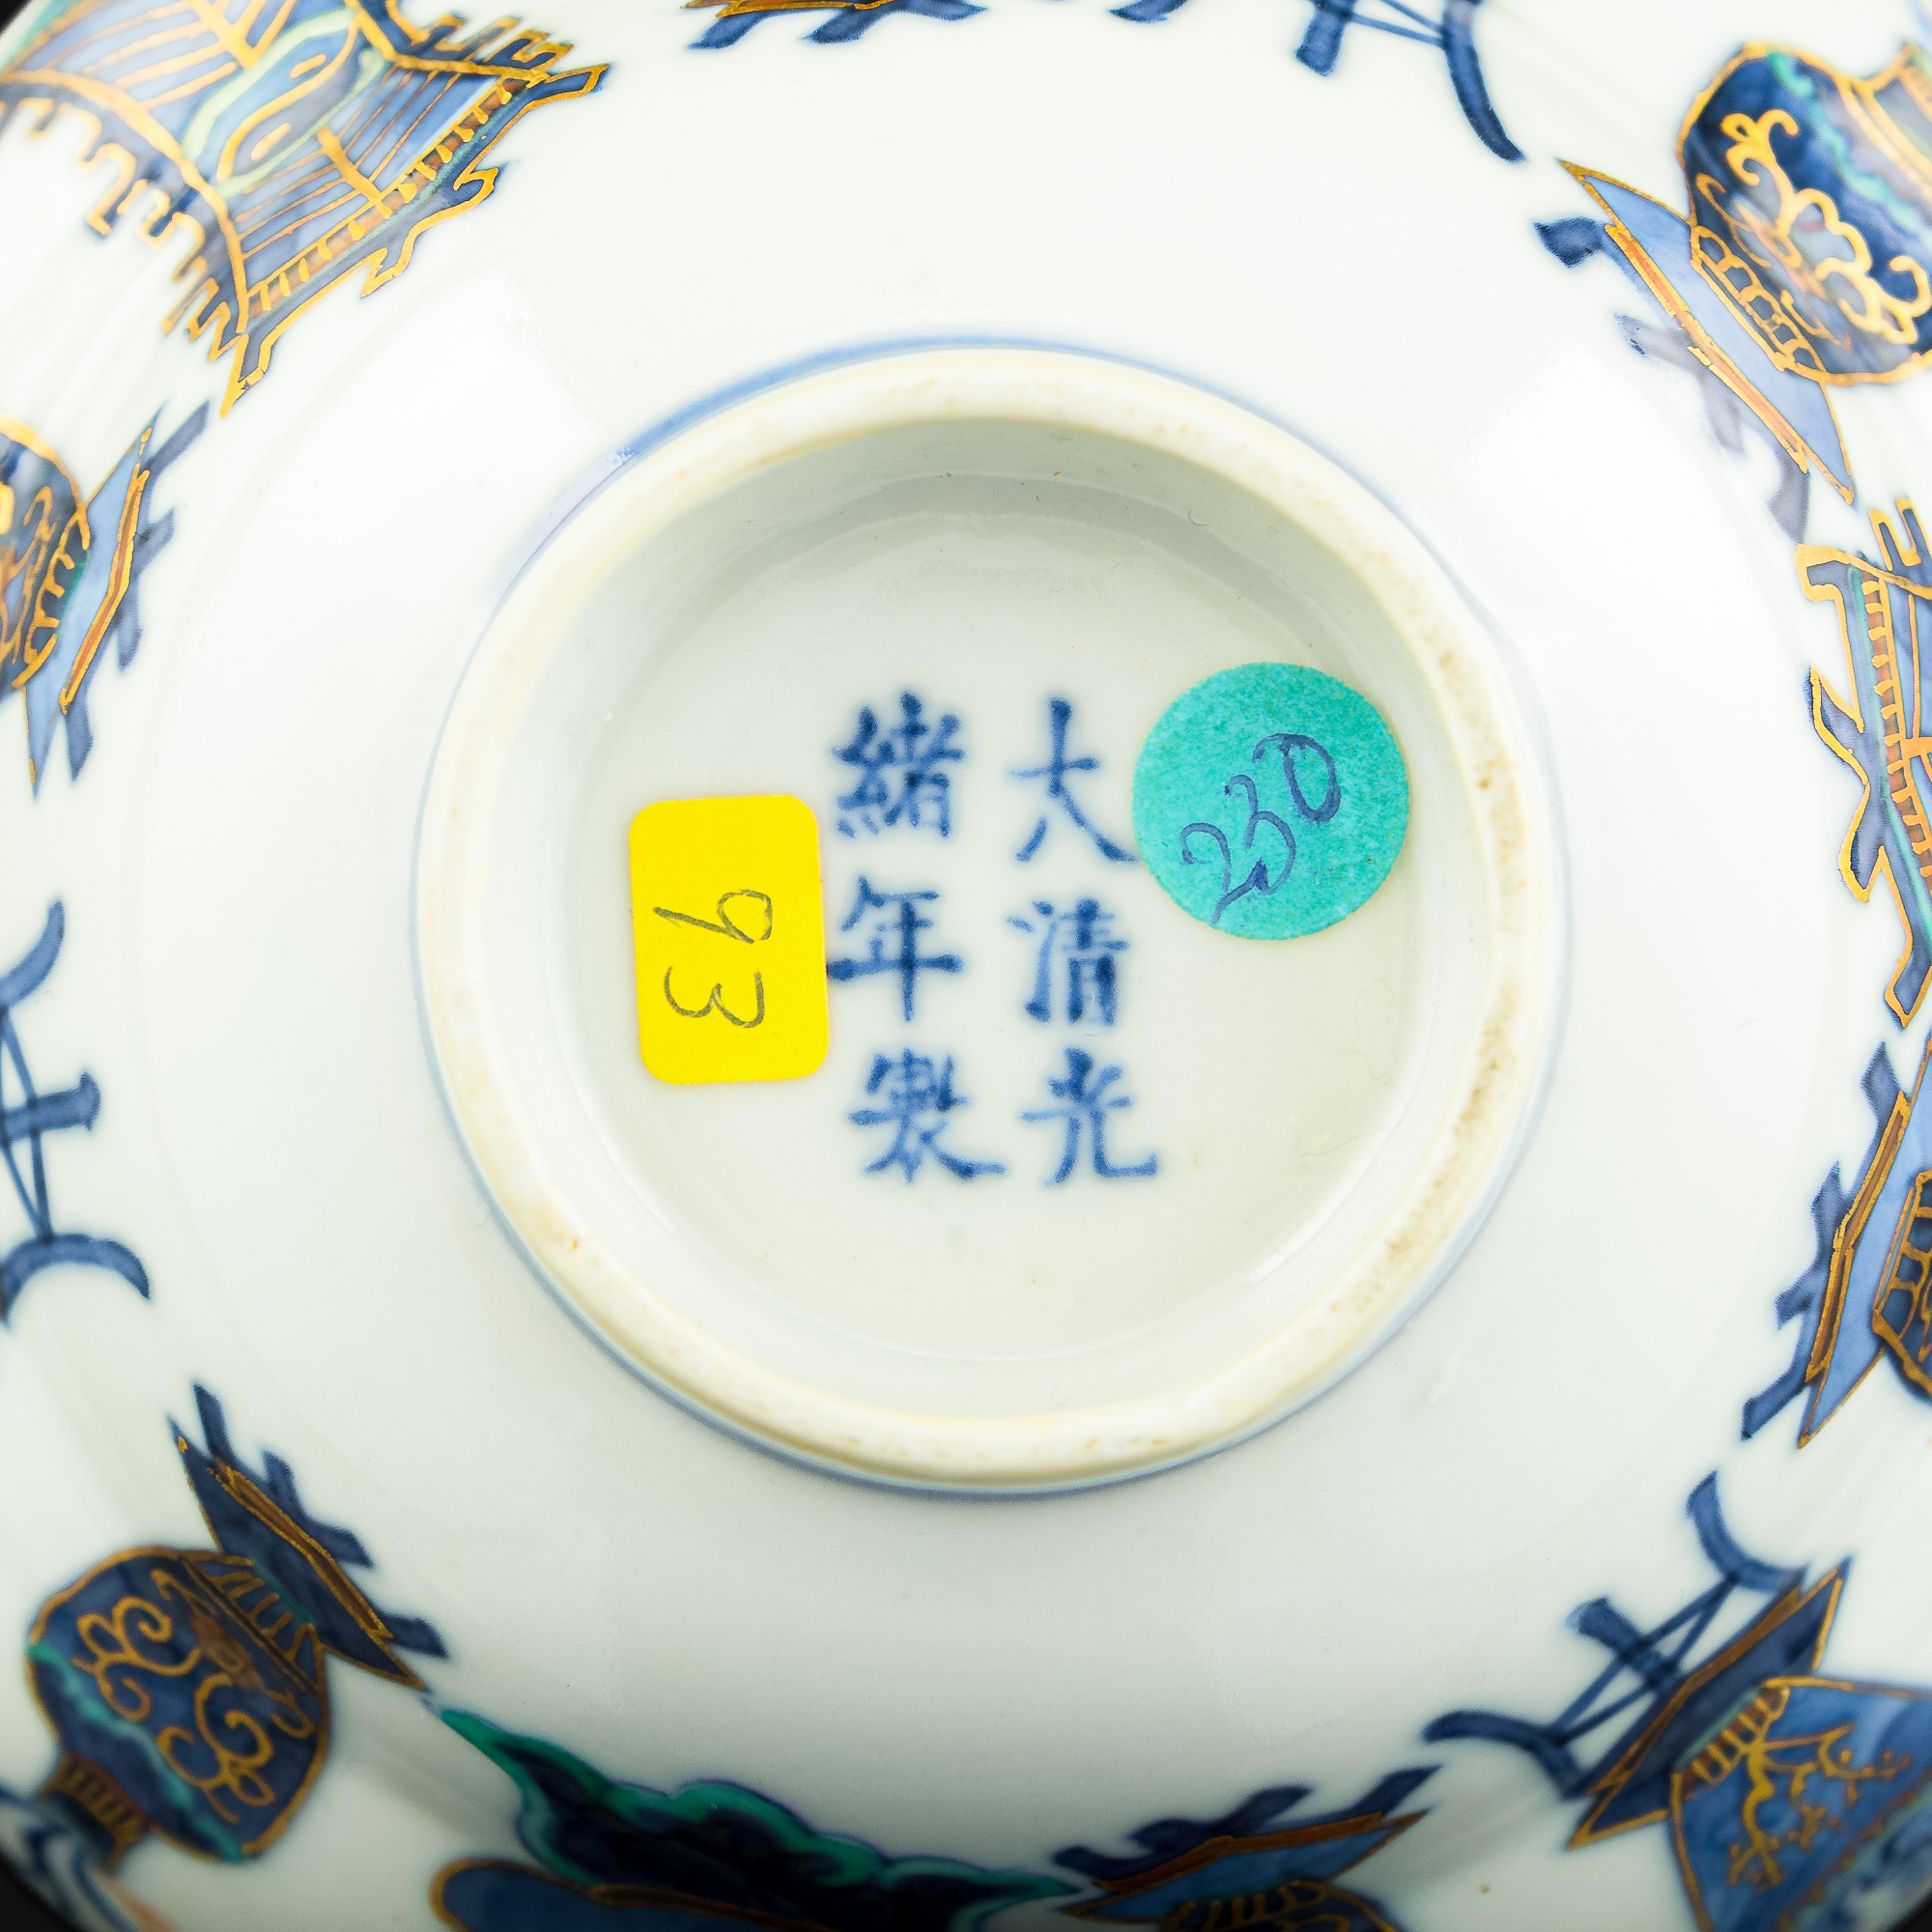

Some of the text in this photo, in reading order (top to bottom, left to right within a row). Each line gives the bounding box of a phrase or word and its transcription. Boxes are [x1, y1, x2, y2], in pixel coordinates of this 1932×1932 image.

[653, 889, 774, 1030] 93
[827, 690, 1007, 1184] 緒年製
[1009, 696, 1158, 1187] 大清光
[1180, 731, 1342, 924] 230
